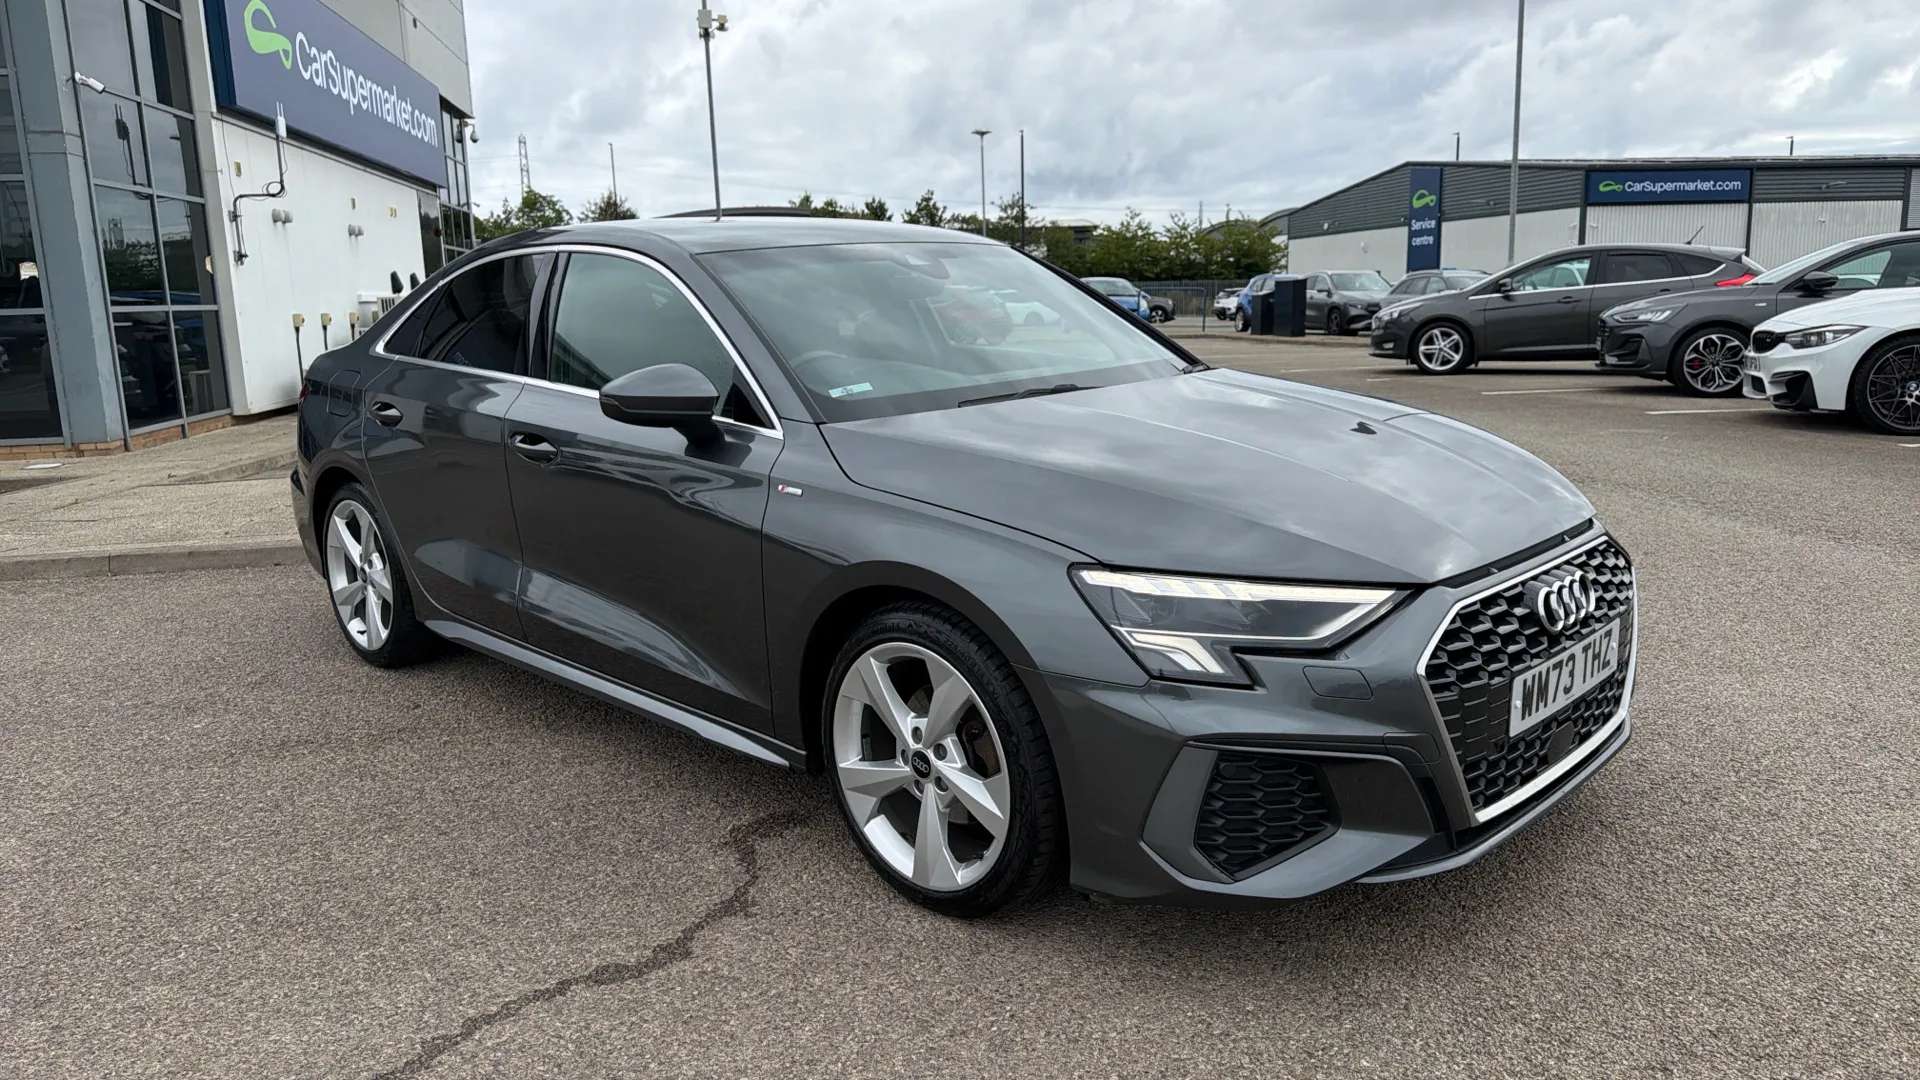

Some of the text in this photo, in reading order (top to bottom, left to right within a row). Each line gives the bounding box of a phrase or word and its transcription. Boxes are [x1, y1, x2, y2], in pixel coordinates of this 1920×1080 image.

[296, 32, 438, 147] CarSupermarket.com
[1624, 179, 1741, 194] CarSupermarket.com
[1411, 218, 1436, 230] Service
[1412, 235, 1433, 245] centre
[1521, 628, 1612, 720] WM73 THZ
